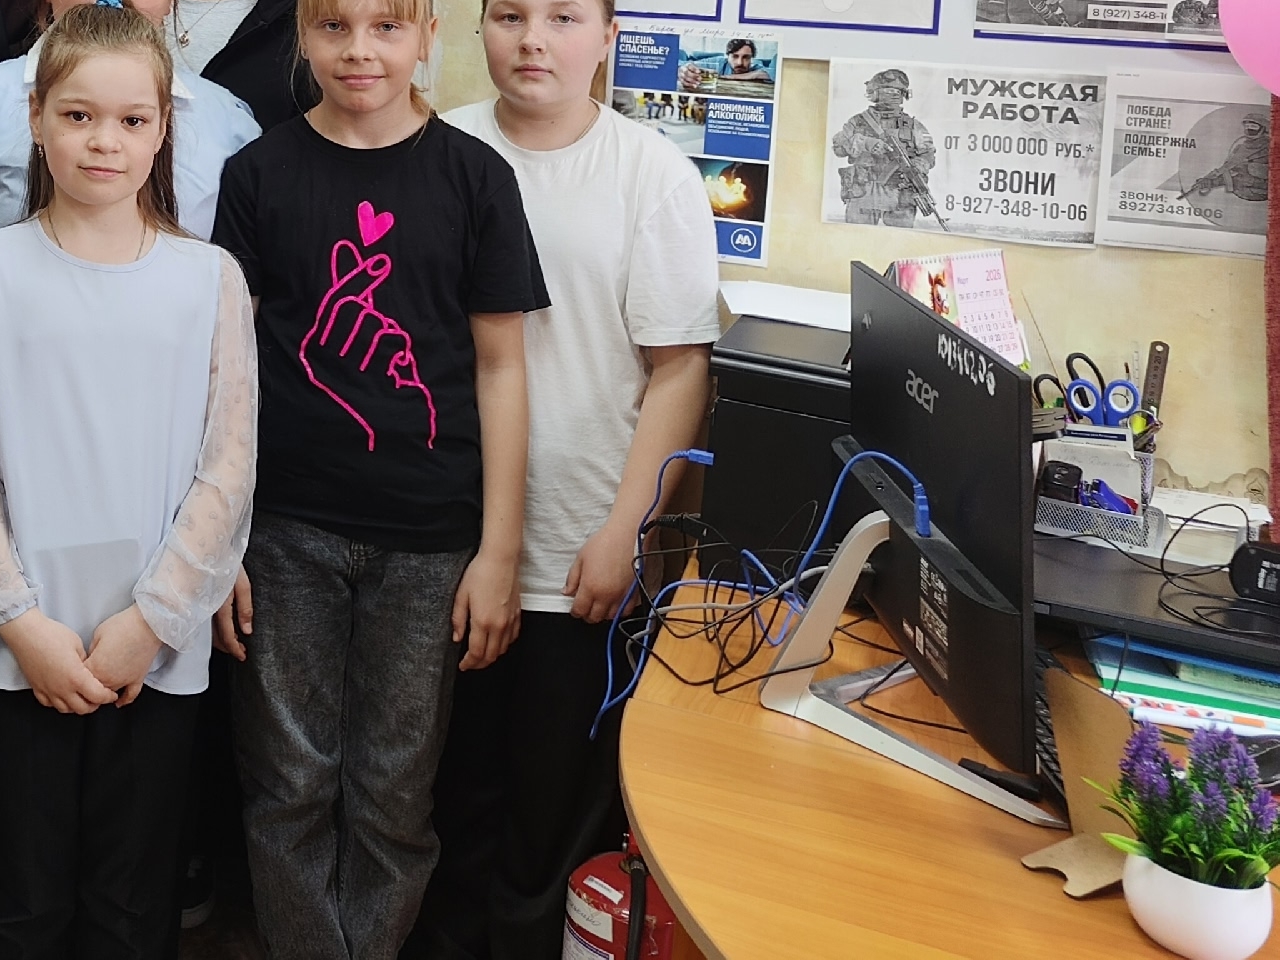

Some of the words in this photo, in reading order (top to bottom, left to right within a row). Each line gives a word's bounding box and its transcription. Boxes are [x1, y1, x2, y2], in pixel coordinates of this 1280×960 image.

[1093, 9, 1099, 17] 8
[1103, 9, 1130, 19] (927)
[620, 34, 654, 44] ИЩЕШЬ
[619, 44, 669, 55] СПАСЕНЬЕ?
[947, 77, 1099, 102] МУЖСКАЯ
[708, 103, 764, 114] АНОНИМНЫЕ
[962, 103, 1080, 125] РАБОТА
[1127, 104, 1172, 117] ПОБЕДА
[708, 110, 764, 123] АЛКОГОЛИКИ
[1126, 116, 1172, 130] СТРАНЕ!
[944, 135, 959, 150] ОТ
[968, 134, 976, 152] 3
[983, 135, 1014, 155] 000
[1017, 137, 1047, 157] 000
[1124, 133, 1197, 149] ПОДДЕРЖКА
[1123, 145, 1166, 158] СЕМЬЕ!
[979, 169, 1055, 196] ЗВОНИ
[1120, 191, 1168, 203] ЗВОНИ:
[945, 194, 1088, 221] 8-927-348-10-06
[1118, 201, 1223, 220] 89273481006
[986, 269, 1001, 281] 2026
[905, 369, 939, 414] acer
